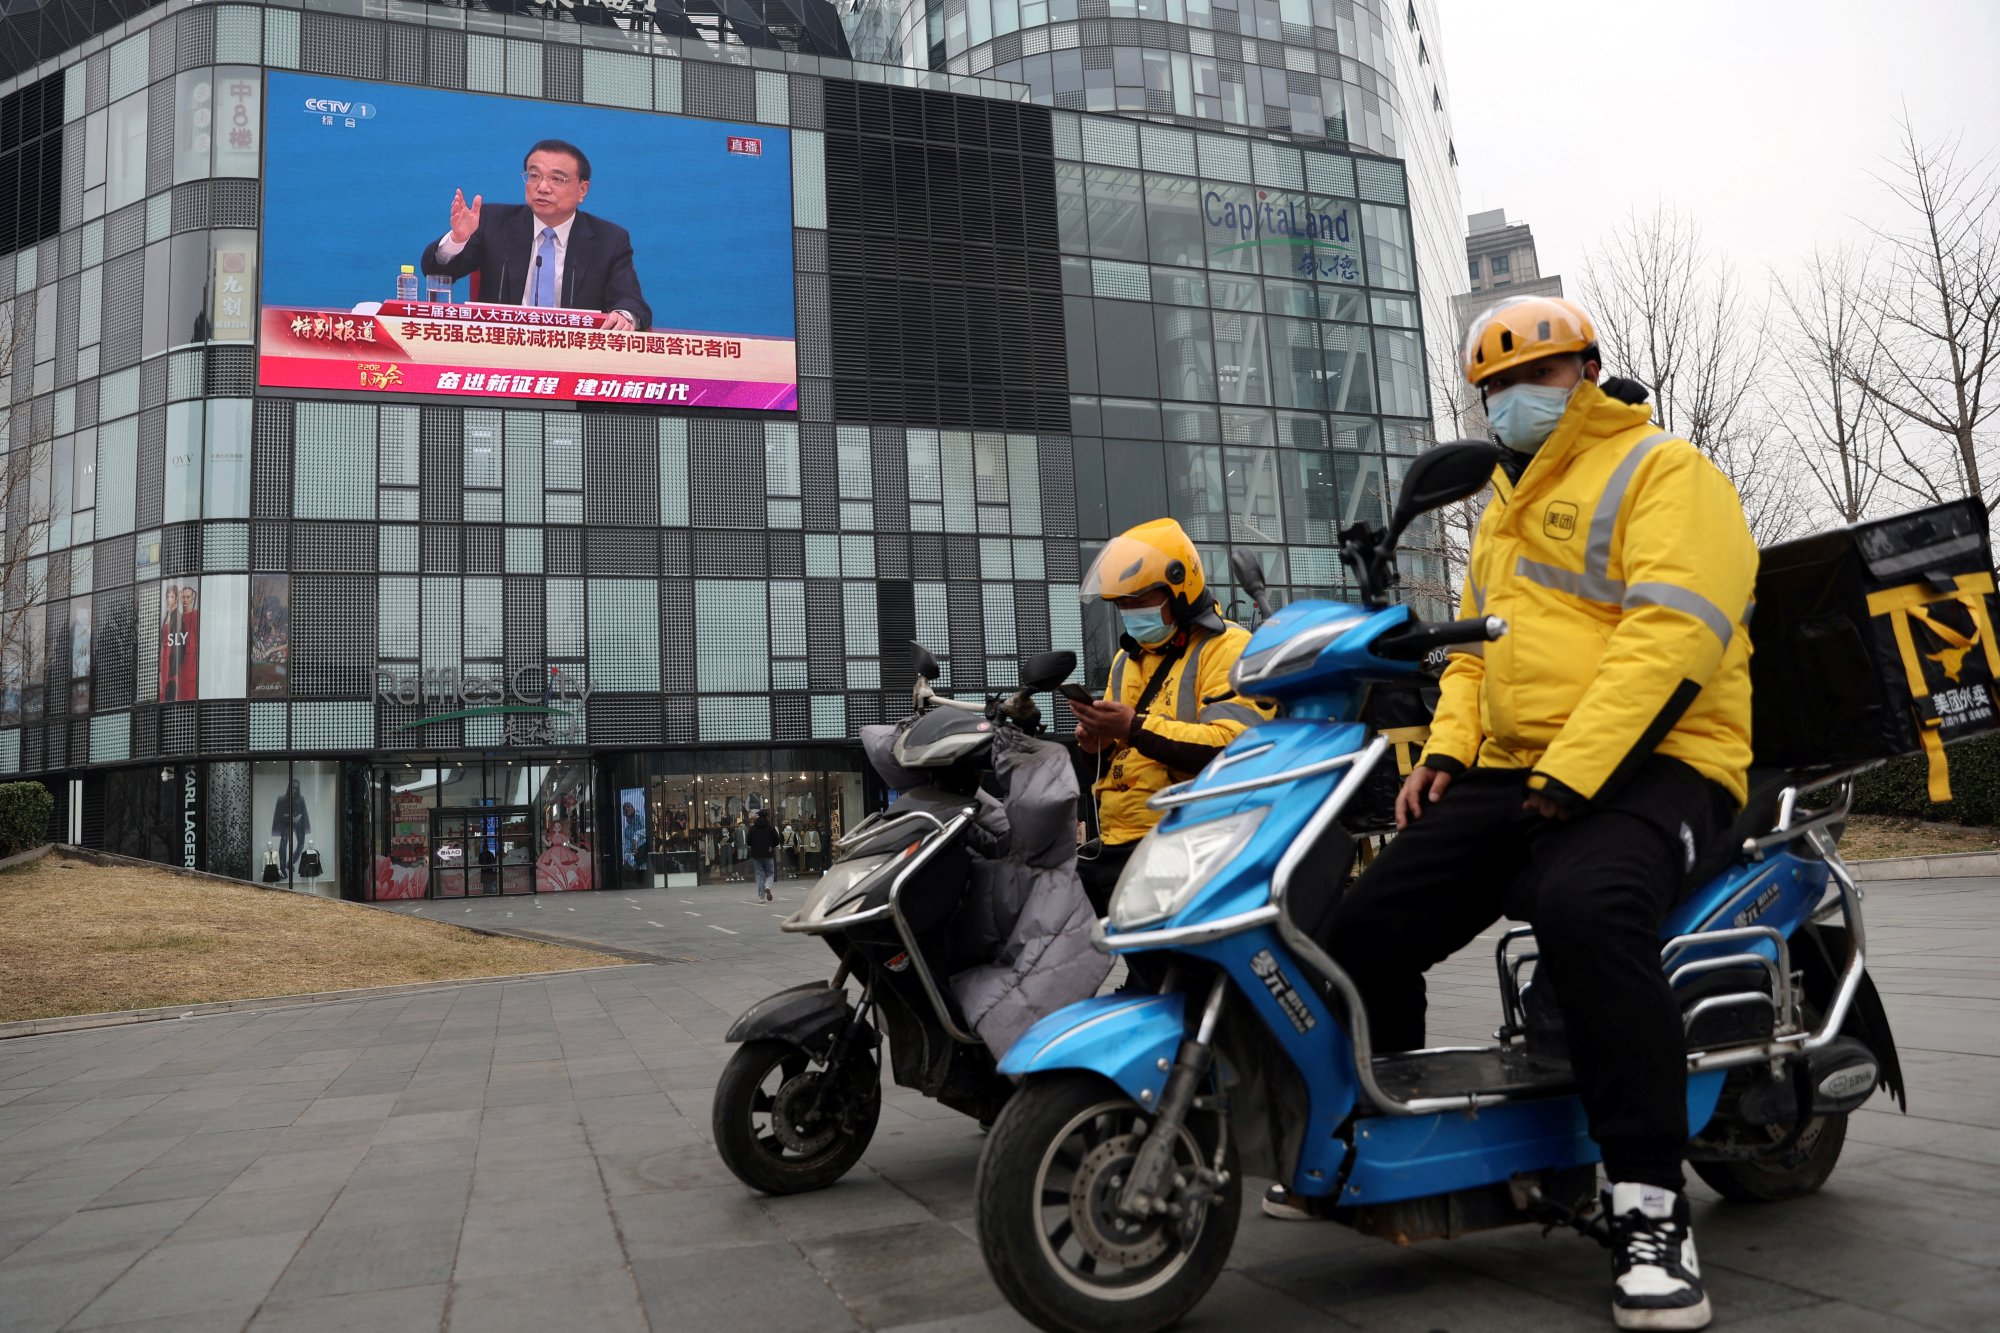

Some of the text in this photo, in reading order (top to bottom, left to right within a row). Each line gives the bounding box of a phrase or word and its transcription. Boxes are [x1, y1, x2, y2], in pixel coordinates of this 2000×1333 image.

[305, 98, 367, 116] CCTV 1
[322, 115, 356, 128] 综合
[731, 139, 757, 152] 直播
[1204, 190, 1350, 243] CapitaLand
[290, 315, 377, 342] 特别报道
[402, 304, 595, 327] 十三届全国人大五次会议记者会
[401, 321, 741, 359] 李克强总理就减税降费等问题答记者问
[437, 372, 690, 401] 奋进新征程 建功新时代
[1546, 512, 1573, 531] 美团
[167, 631, 189, 647] SLY
[371, 663, 598, 712] Raffles City
[1932, 683, 1990, 716] 美团外卖
[185, 764, 196, 870] KARL LAGER
